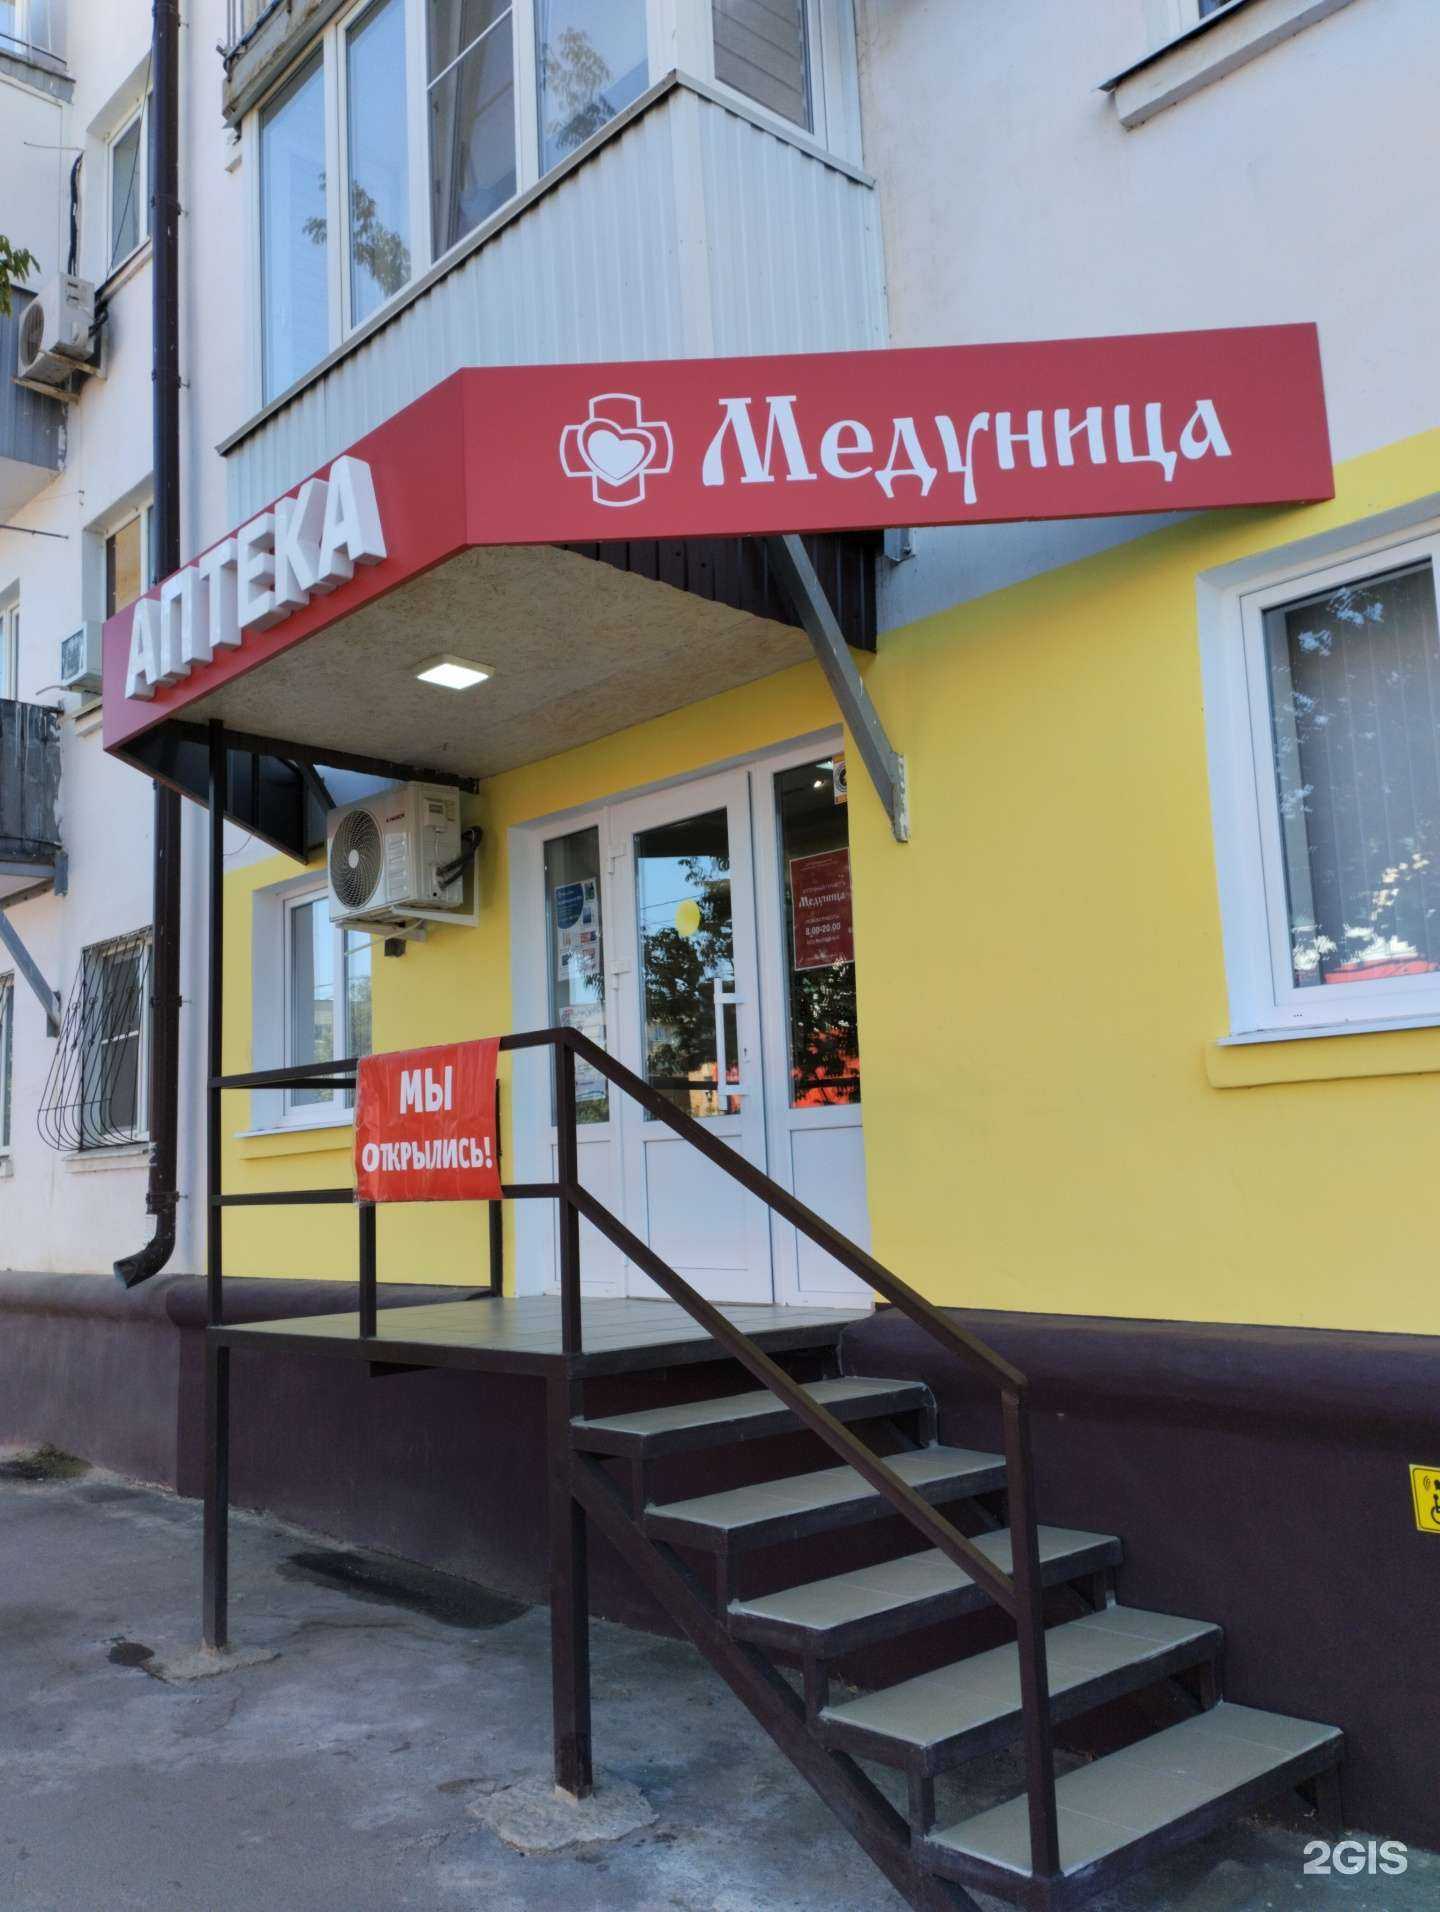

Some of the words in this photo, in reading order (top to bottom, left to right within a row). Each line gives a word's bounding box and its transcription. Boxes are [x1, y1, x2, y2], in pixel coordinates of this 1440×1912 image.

[702, 394, 1232, 504] Медуница
[124, 454, 388, 701] АПТЕКА
[399, 1065, 453, 1115] МЫ
[361, 1136, 493, 1173] ОТКРЫЛИСЬ!
